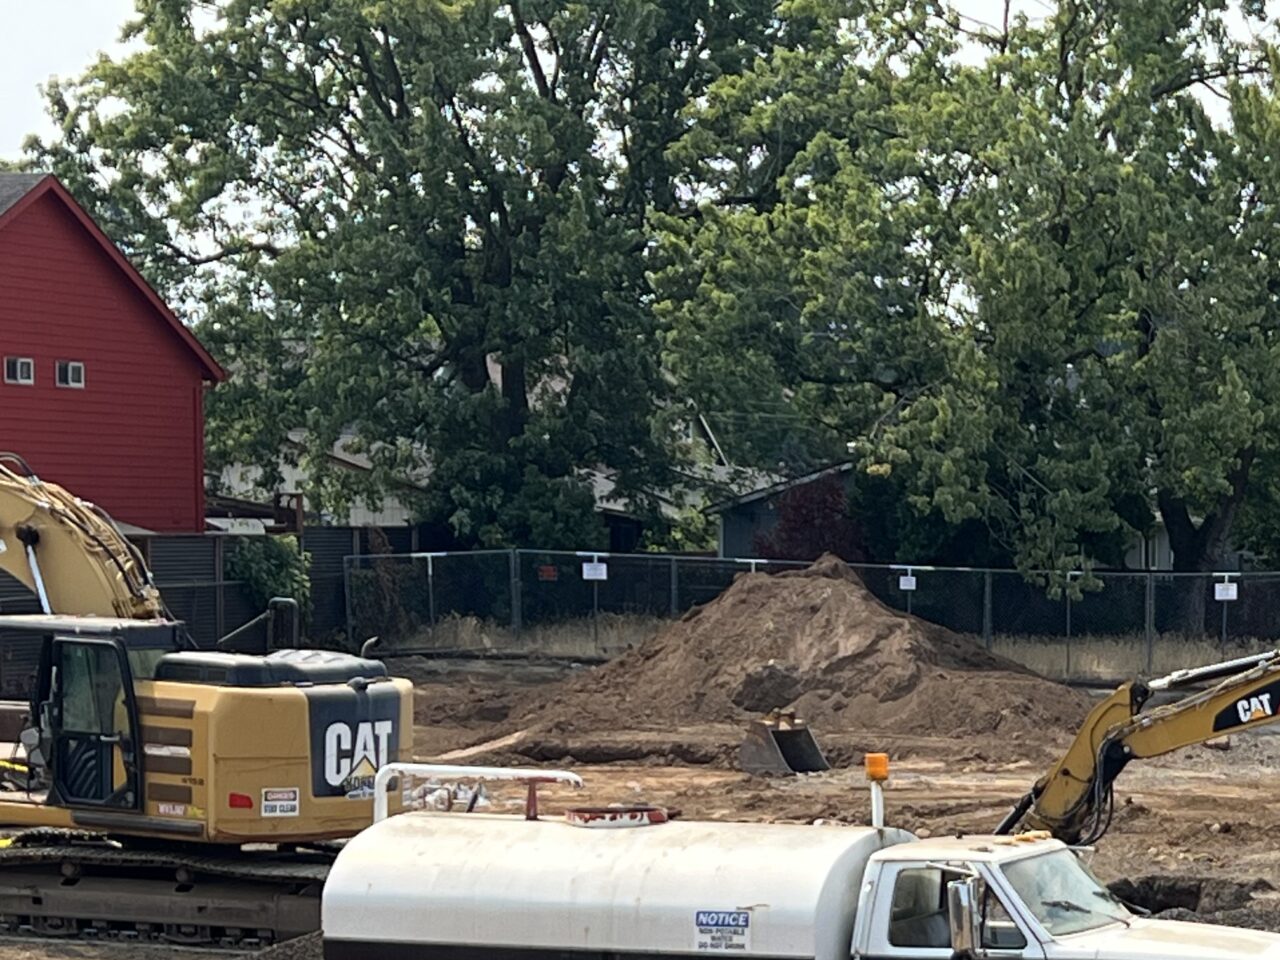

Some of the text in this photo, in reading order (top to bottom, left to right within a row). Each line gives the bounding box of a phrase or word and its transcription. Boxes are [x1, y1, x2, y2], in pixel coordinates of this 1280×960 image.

[1236, 692, 1273, 723] CAT
[325, 720, 392, 787] CAT
[698, 912, 748, 926] NOTICE
